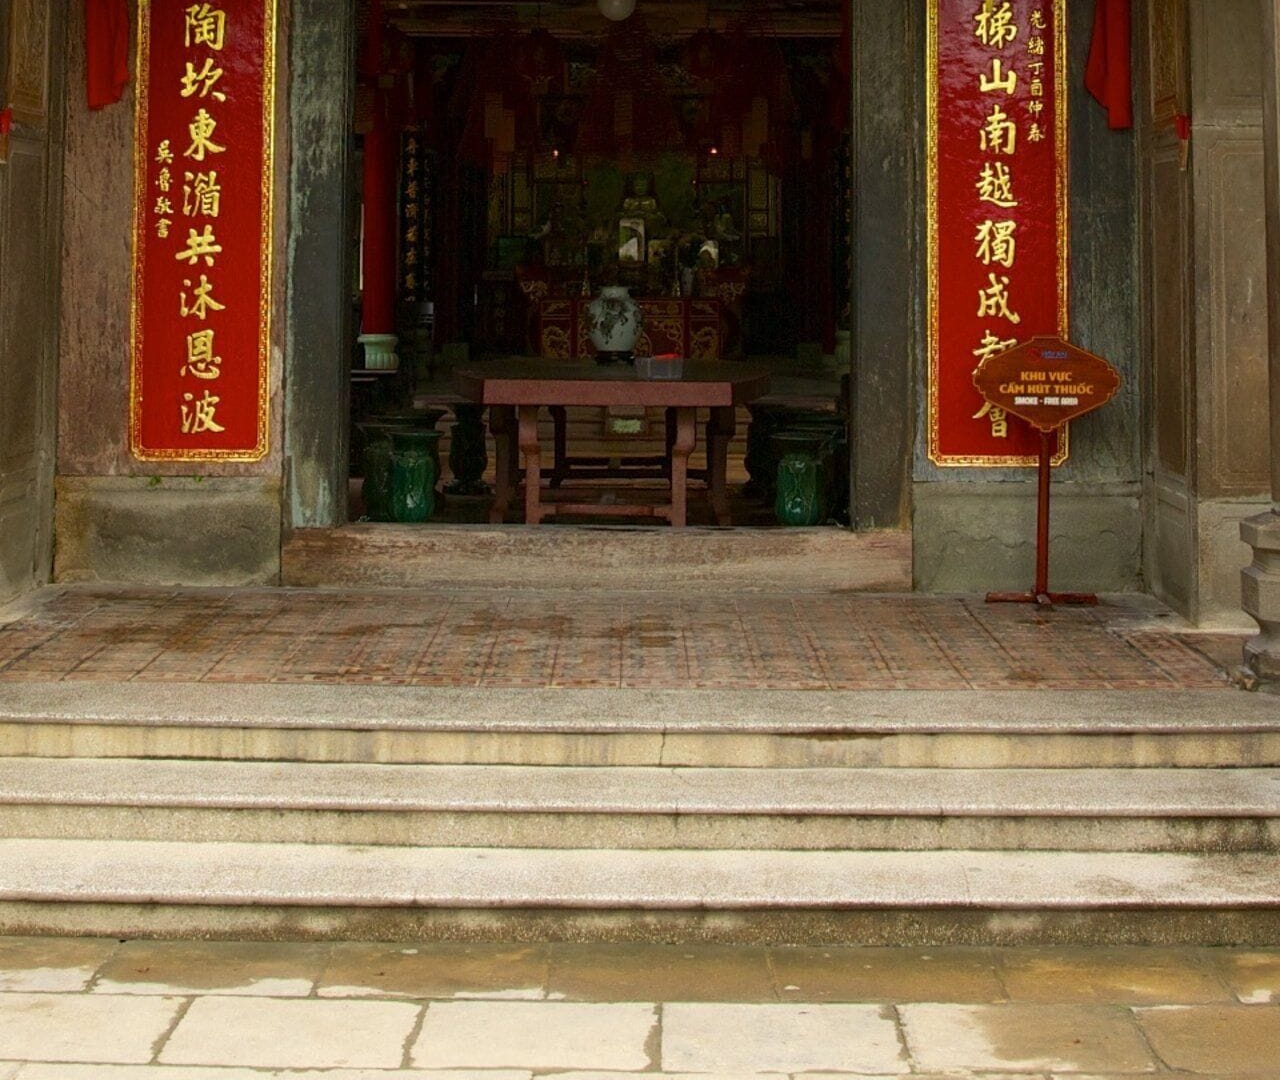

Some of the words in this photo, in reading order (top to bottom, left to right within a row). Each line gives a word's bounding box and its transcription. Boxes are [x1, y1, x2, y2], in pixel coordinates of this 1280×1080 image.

[1021, 371, 1045, 381] KHU
[1048, 371, 1073, 383] VỰC
[999, 382, 1025, 394] CẤM
[1053, 381, 1094, 395] THUỐC
